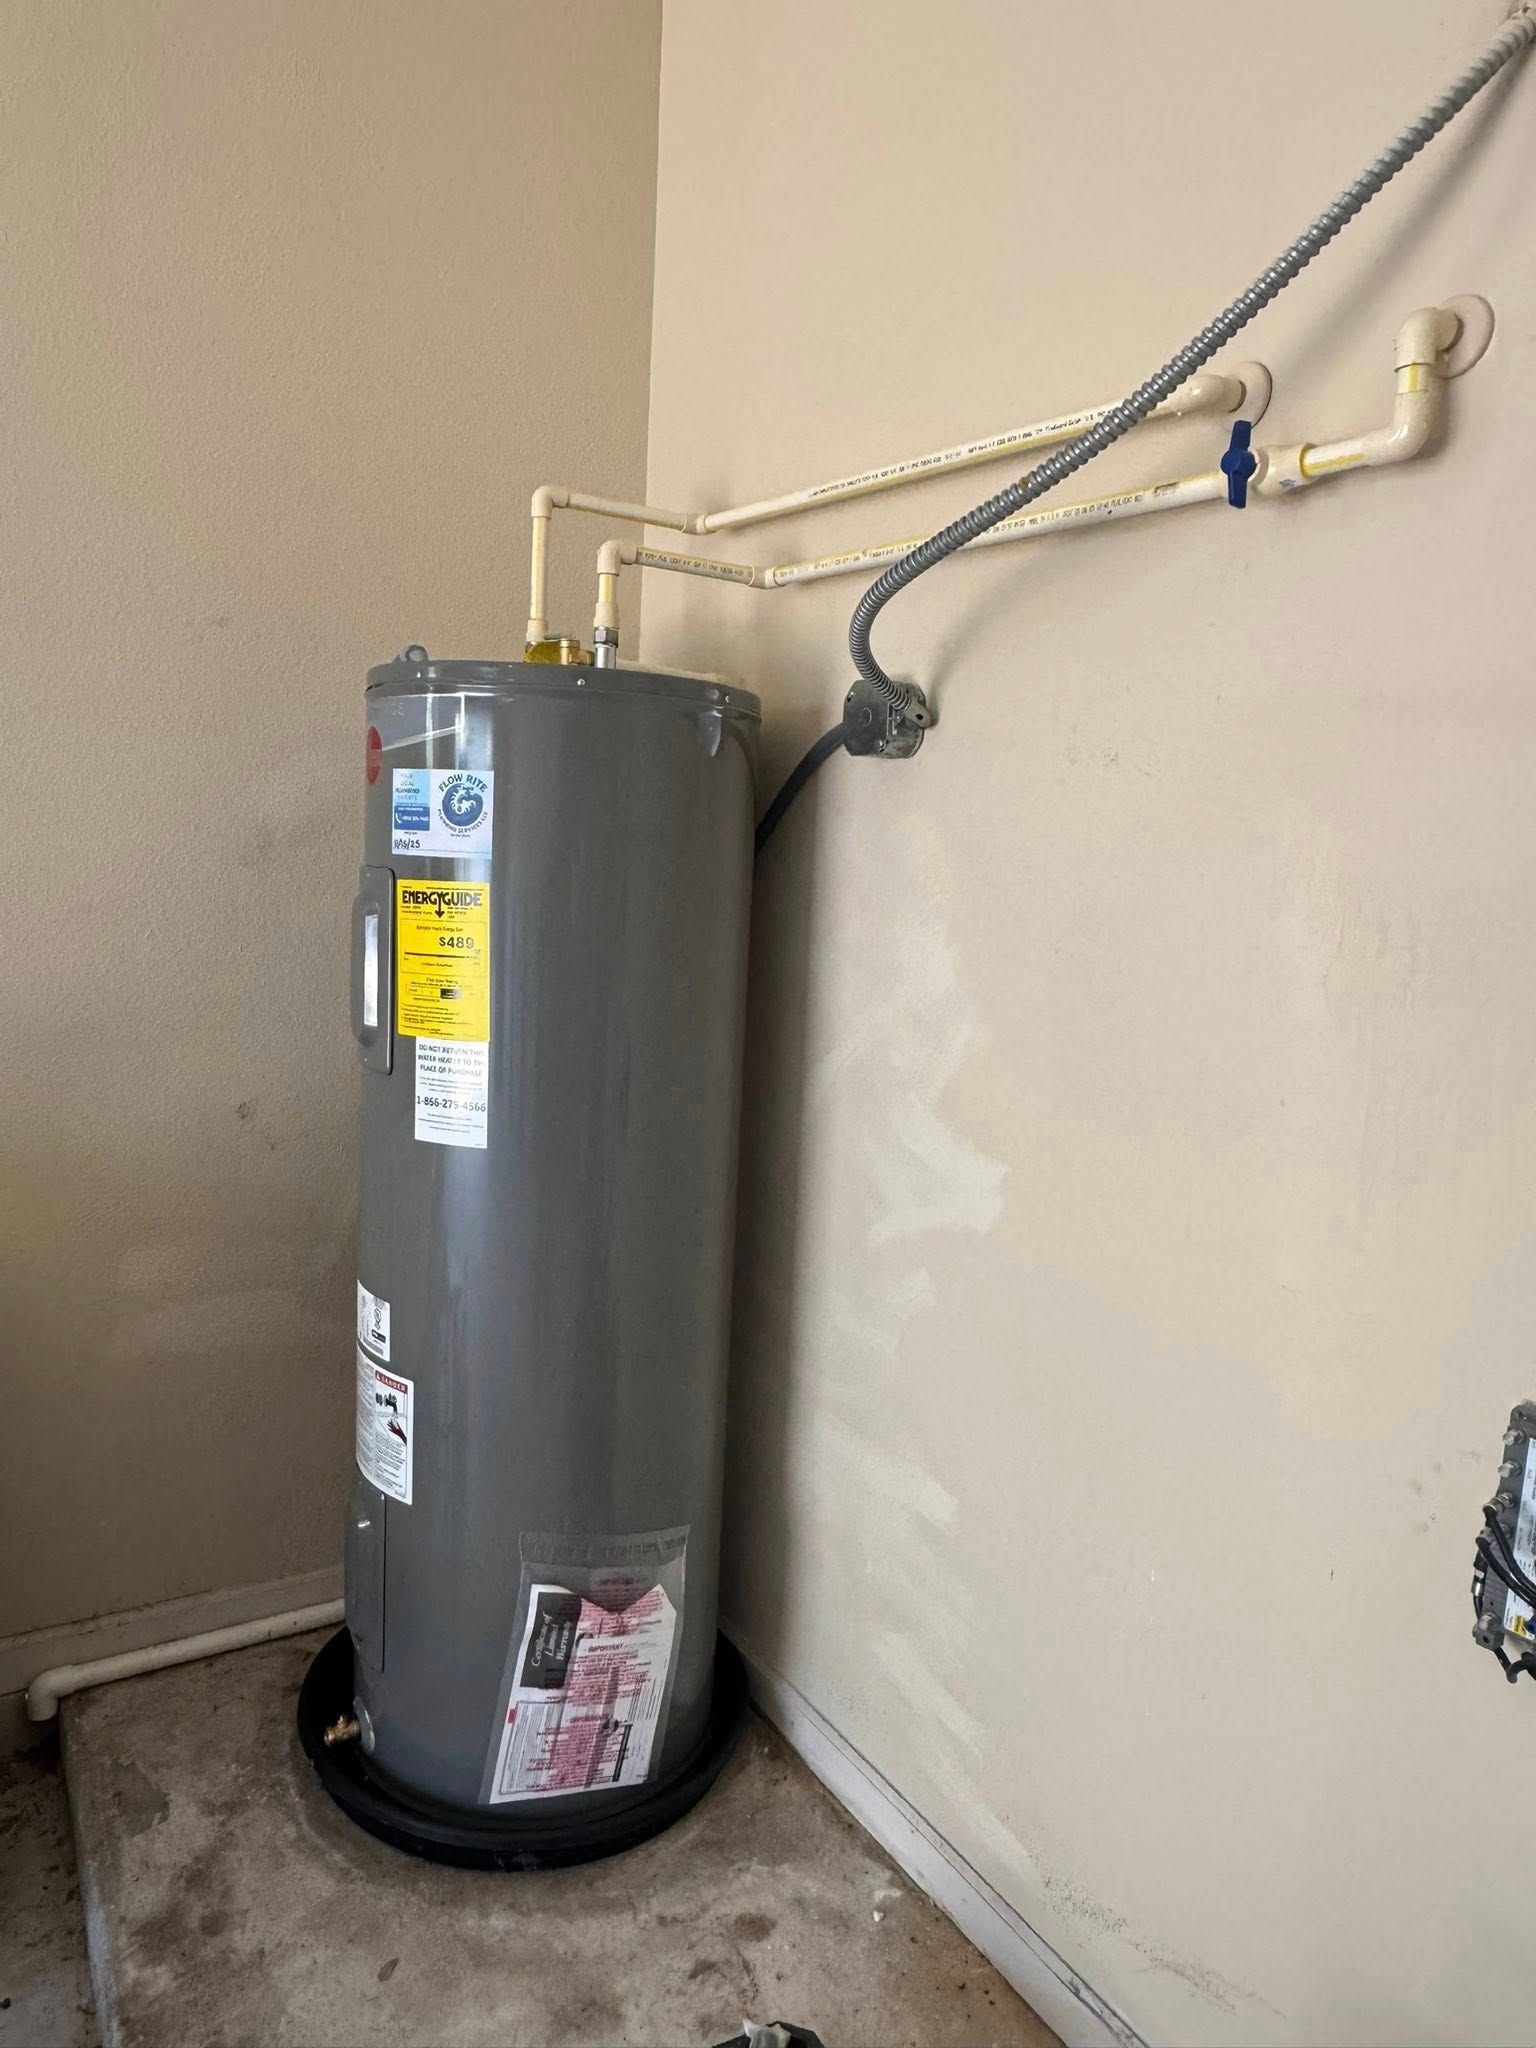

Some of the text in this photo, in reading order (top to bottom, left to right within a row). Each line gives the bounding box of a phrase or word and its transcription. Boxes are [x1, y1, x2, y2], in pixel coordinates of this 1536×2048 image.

[438, 773, 488, 794] FLOW RITE
[402, 889, 482, 906] ENERGYGUIDE
[417, 1054, 436, 1062] WATER
[420, 1064, 437, 1073] PLACE
[448, 1067, 482, 1077] PURCHASE
